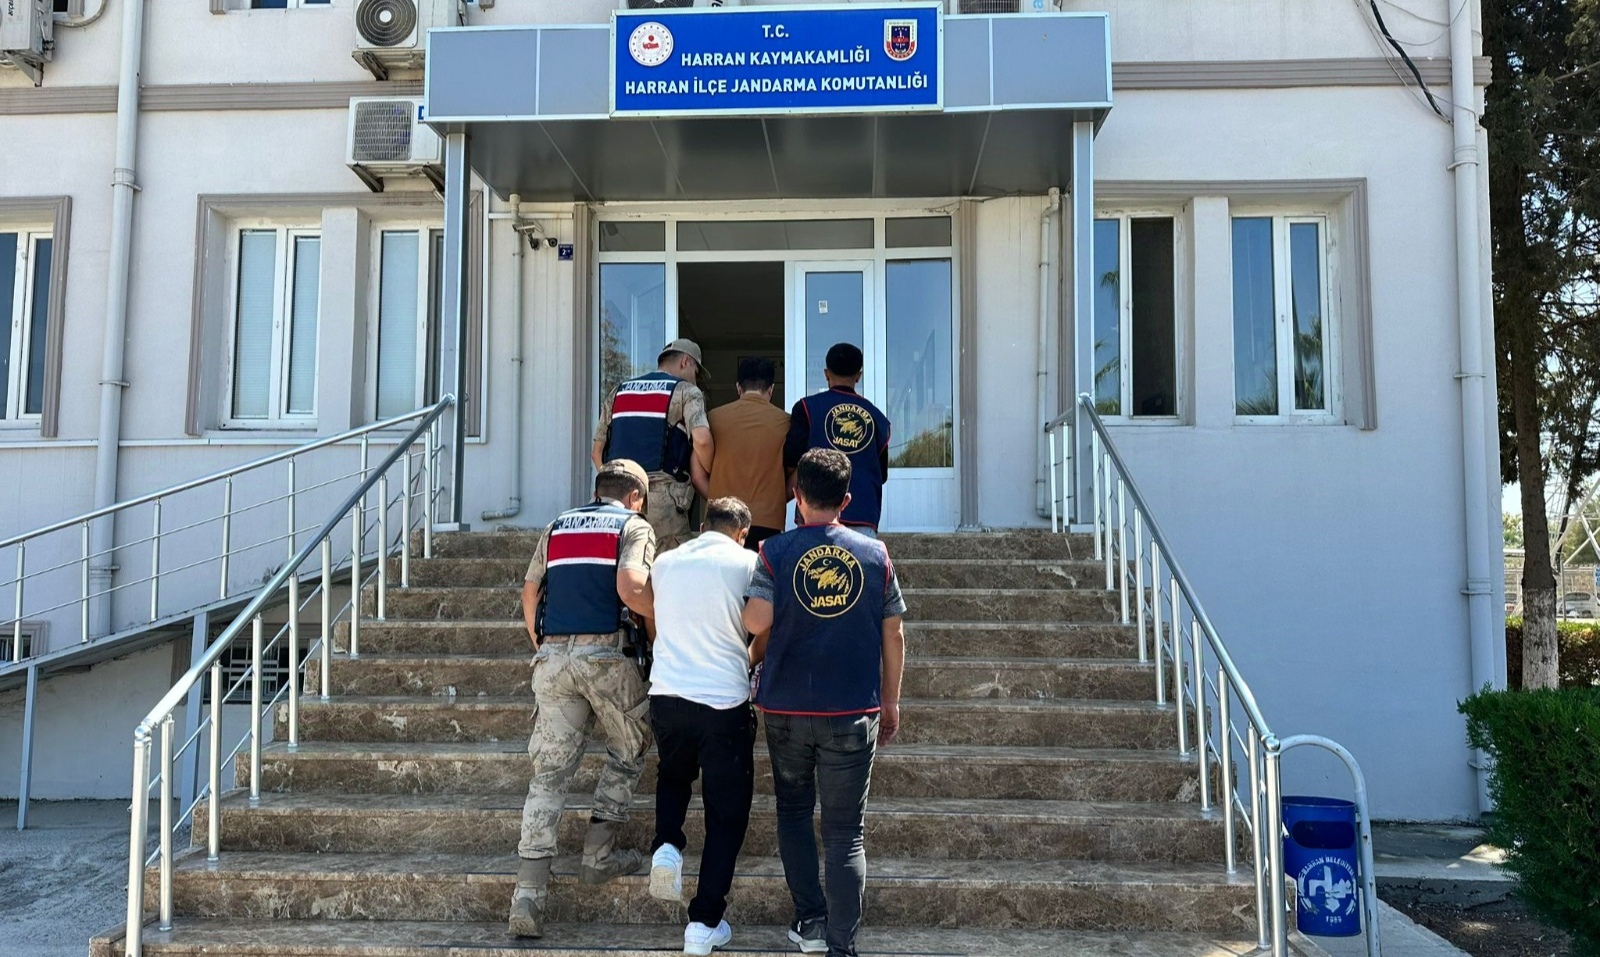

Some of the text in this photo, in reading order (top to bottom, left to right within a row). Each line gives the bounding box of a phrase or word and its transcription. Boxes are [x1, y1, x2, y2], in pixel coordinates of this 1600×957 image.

[762, 25, 790, 38] T.C.
[681, 52, 746, 67] HARRAN
[750, 45, 870, 65] KAYMAKAMLIĞI
[625, 71, 928, 96] HARRAN İLÇE JANDARMA KOMUTANLIĞI
[622, 382, 667, 392] JANDARMA
[831, 405, 872, 425] JANDARMA
[832, 436, 859, 448] JASAT
[559, 516, 617, 530] JANDARMA
[800, 546, 856, 571] JANDARMA
[810, 594, 848, 608] JASAT
